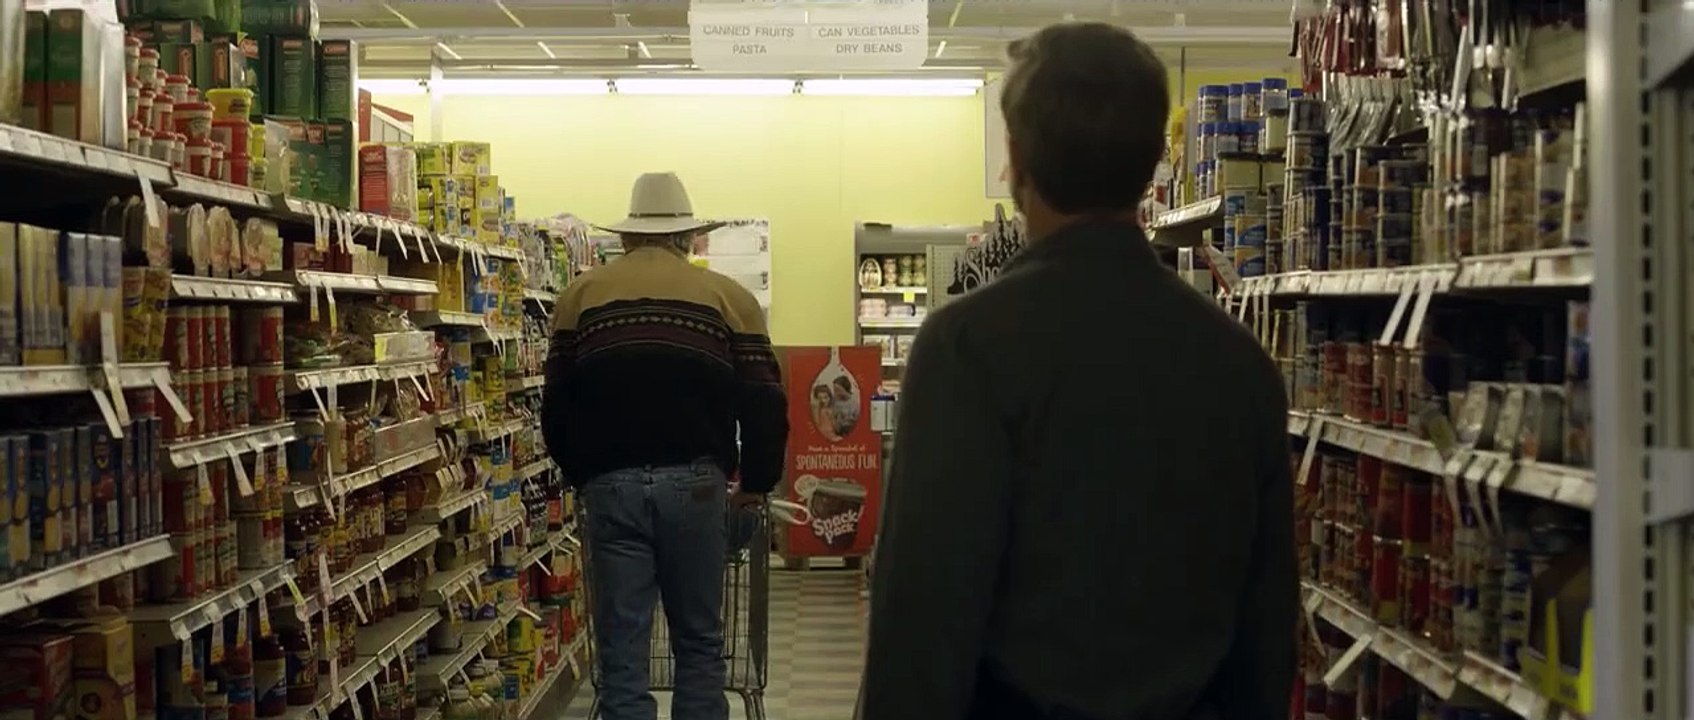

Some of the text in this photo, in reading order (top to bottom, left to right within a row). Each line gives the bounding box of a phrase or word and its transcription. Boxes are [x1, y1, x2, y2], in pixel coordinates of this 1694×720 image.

[703, 25, 795, 38] CANNED FRUITS
[818, 24, 920, 38] CAN VEGETABLES
[732, 44, 767, 55] PASTA
[836, 43, 903, 54] DRY BEANS
[795, 454, 855, 470] SPONTANEOUS
[812, 509, 858, 537] Snack
